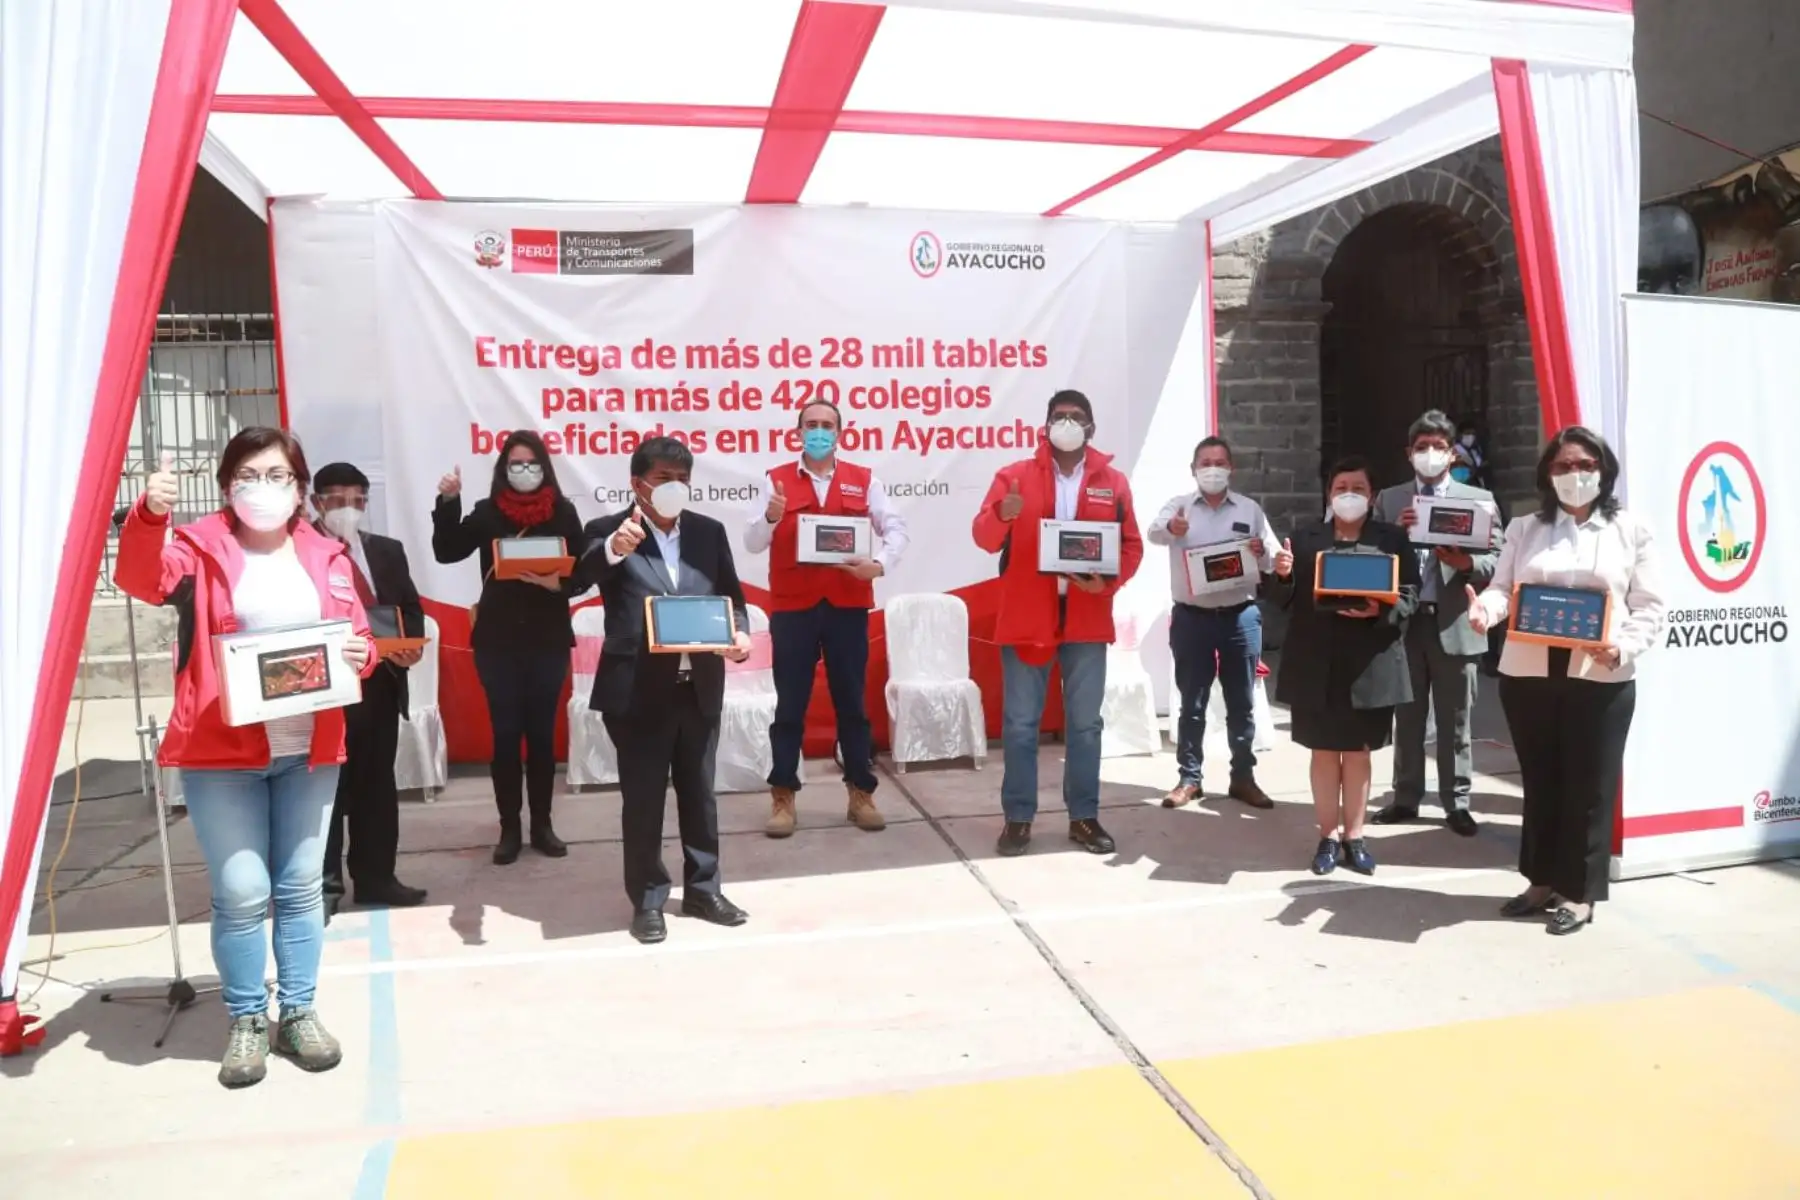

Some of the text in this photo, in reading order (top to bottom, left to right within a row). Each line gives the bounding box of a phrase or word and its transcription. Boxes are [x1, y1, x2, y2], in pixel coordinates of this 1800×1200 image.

[565, 236, 621, 247] Ministerio
[946, 242, 1044, 253] GOBIERNO REGIONAL DE
[517, 243, 553, 258] PERÚ
[565, 246, 645, 259] de Transportes
[565, 256, 662, 271] y Comunicaciones
[946, 253, 1046, 270] AYACUCHO
[475, 336, 1049, 376] Entrega de más de 28 mil tablets
[541, 378, 993, 419] para más de 420 colegios
[470, 422, 708, 455] beeficiados
[716, 427, 760, 454] en
[768, 420, 884, 453] reón
[688, 484, 704, 502] la
[708, 484, 760, 502] brech
[884, 479, 949, 498] ucación
[1667, 605, 1788, 623] GOBIERNO REGIONAL
[1665, 620, 1788, 649] AYACUCHO
